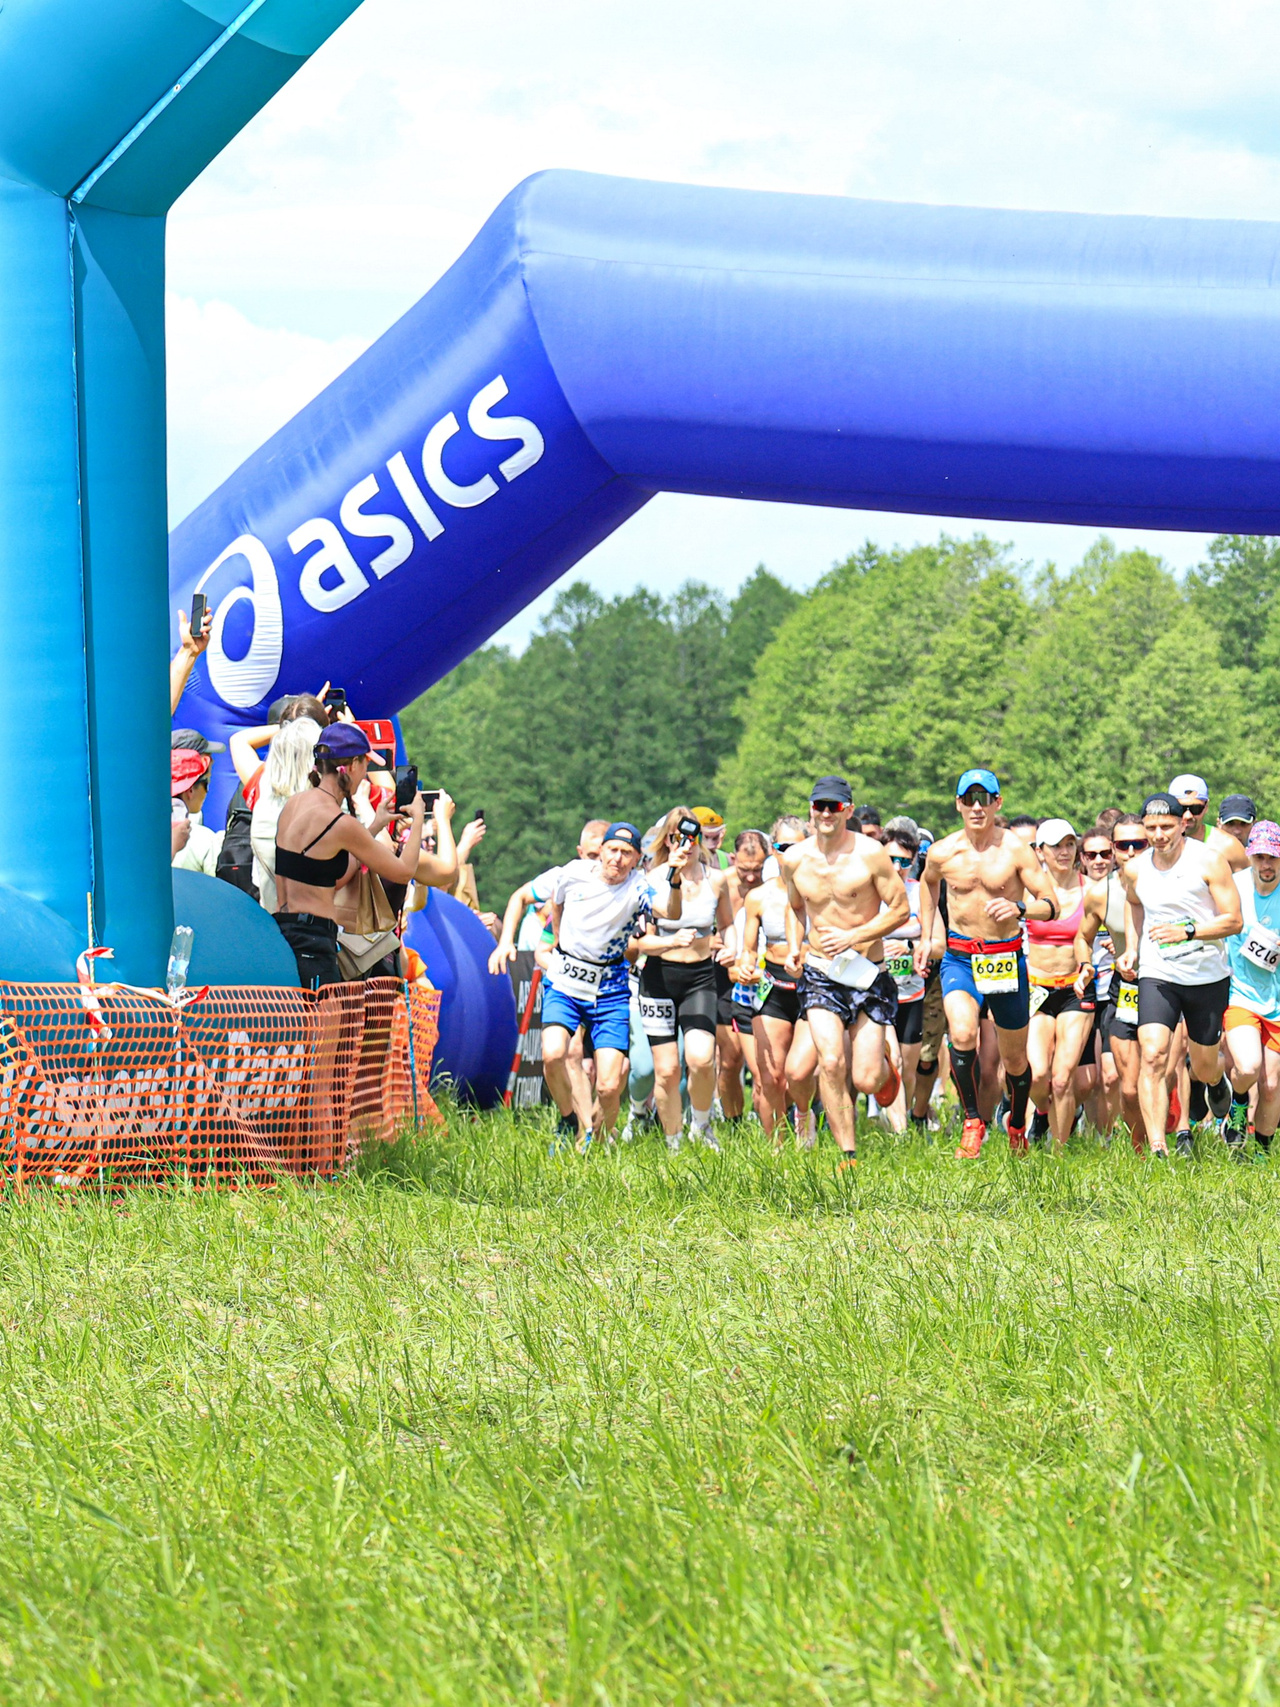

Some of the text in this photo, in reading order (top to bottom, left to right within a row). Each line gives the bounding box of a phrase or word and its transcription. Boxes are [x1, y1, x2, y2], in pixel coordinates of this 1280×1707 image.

[286, 374, 545, 613] asics
[1248, 941, 1279, 965] 9125
[885, 959, 909, 970] 580
[976, 961, 1014, 974] 6020
[563, 963, 598, 984] 9523
[1124, 991, 1139, 1004] 60
[642, 1005, 673, 1019] 9555
